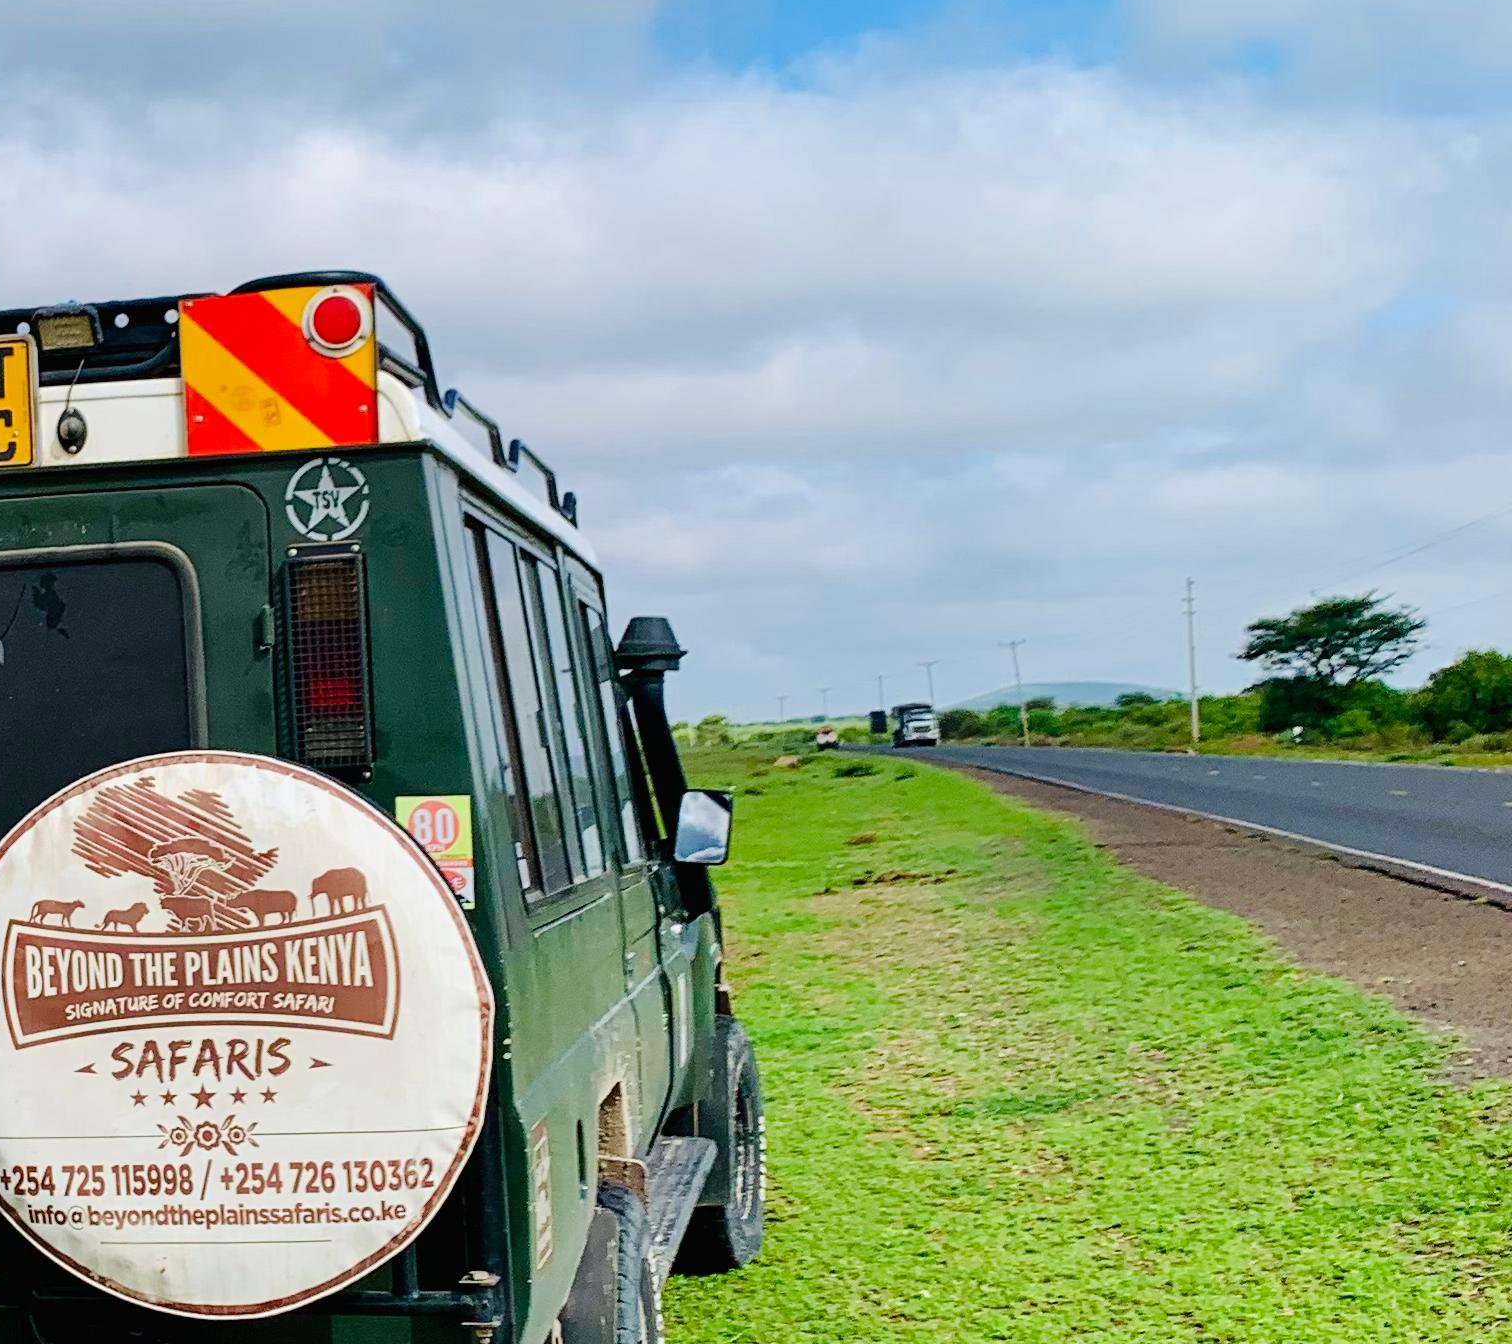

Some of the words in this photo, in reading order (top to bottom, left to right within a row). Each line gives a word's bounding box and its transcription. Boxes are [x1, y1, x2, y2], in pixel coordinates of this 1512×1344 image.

[312, 490, 340, 510] TSV
[412, 807, 455, 846] 80
[25, 944, 124, 1000] BEYOND
[129, 952, 178, 987] THE
[186, 941, 279, 987] PLAINS
[285, 930, 374, 988] KENYA
[65, 993, 160, 1021] SIGNATURE
[163, 992, 186, 1010] OF
[188, 991, 270, 1010] COMFORT
[272, 994, 335, 1014] SAFARI
[111, 1037, 292, 1083] SAFARIS
[0, 1165, 55, 1197] +254
[62, 1165, 105, 1197] 725
[111, 1163, 194, 1197] 115998
[200, 1159, 212, 1200] /
[220, 1161, 283, 1195] +254
[289, 1160, 336, 1194] 726
[342, 1158, 435, 1193] 130362
[28, 1199, 407, 1230] info@beyondtheplainssafaris.co.ke
